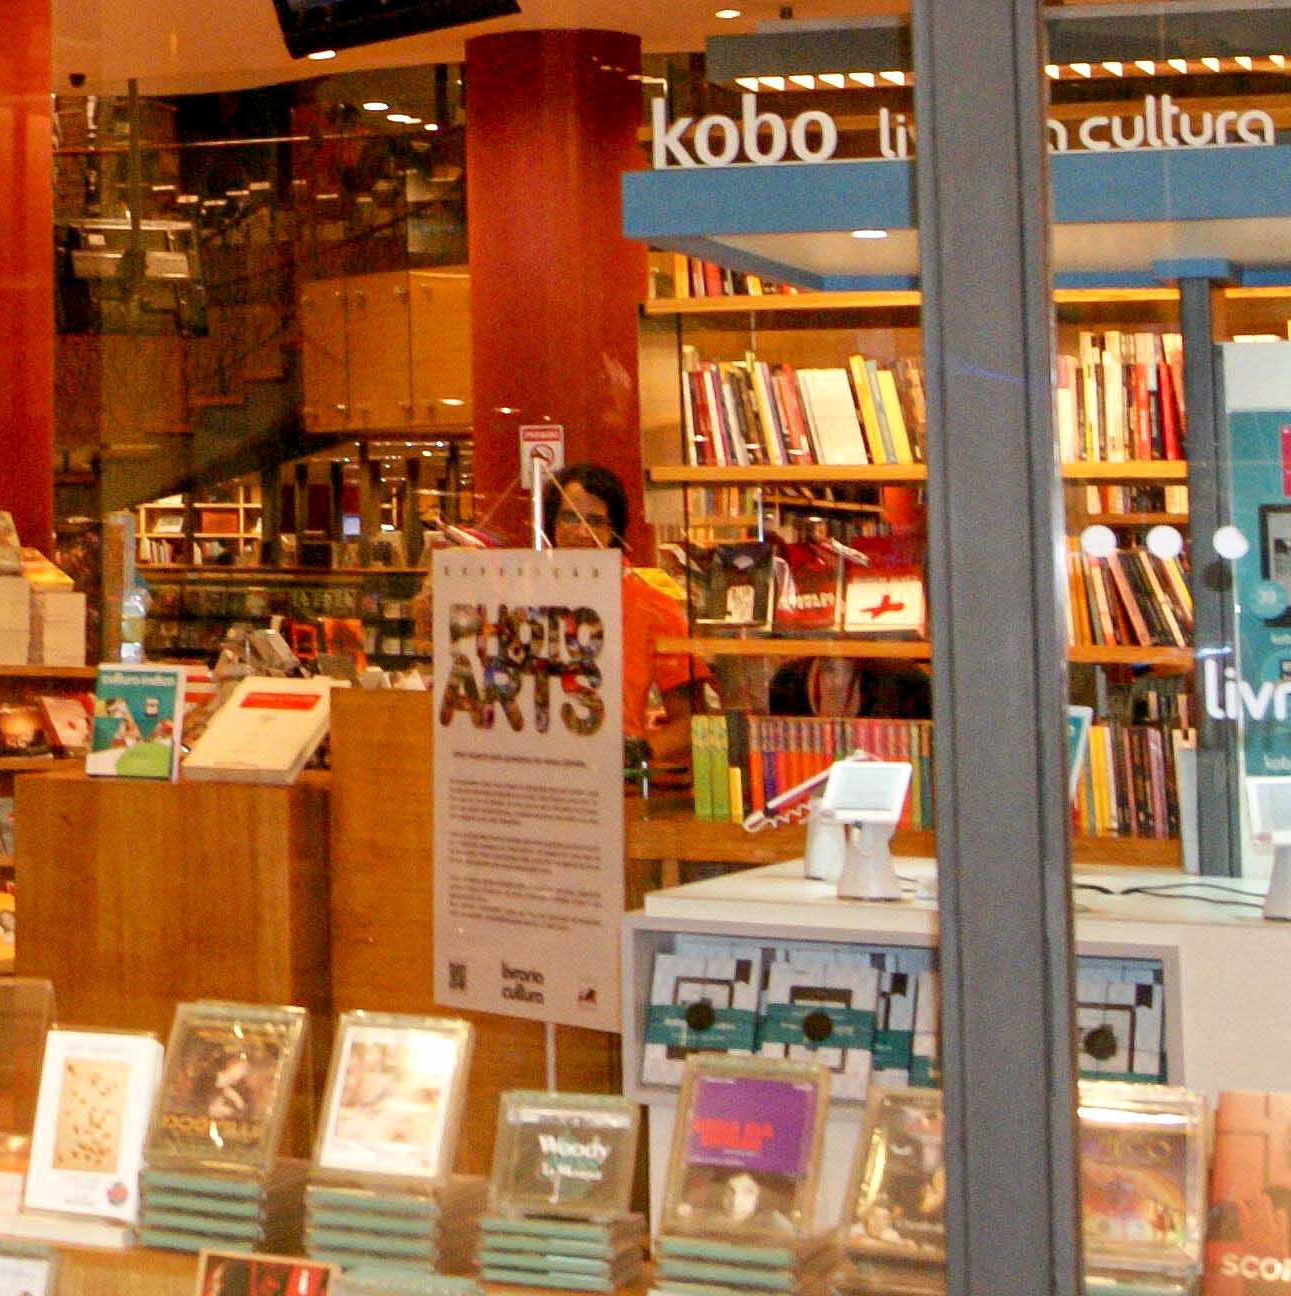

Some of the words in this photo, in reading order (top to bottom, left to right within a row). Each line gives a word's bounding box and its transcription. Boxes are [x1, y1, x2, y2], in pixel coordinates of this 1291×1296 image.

[651, 92, 838, 170] kobo
[1078, 93, 1276, 152] cultura
[449, 603, 605, 666] PHOTO
[439, 655, 606, 737] ARTS
